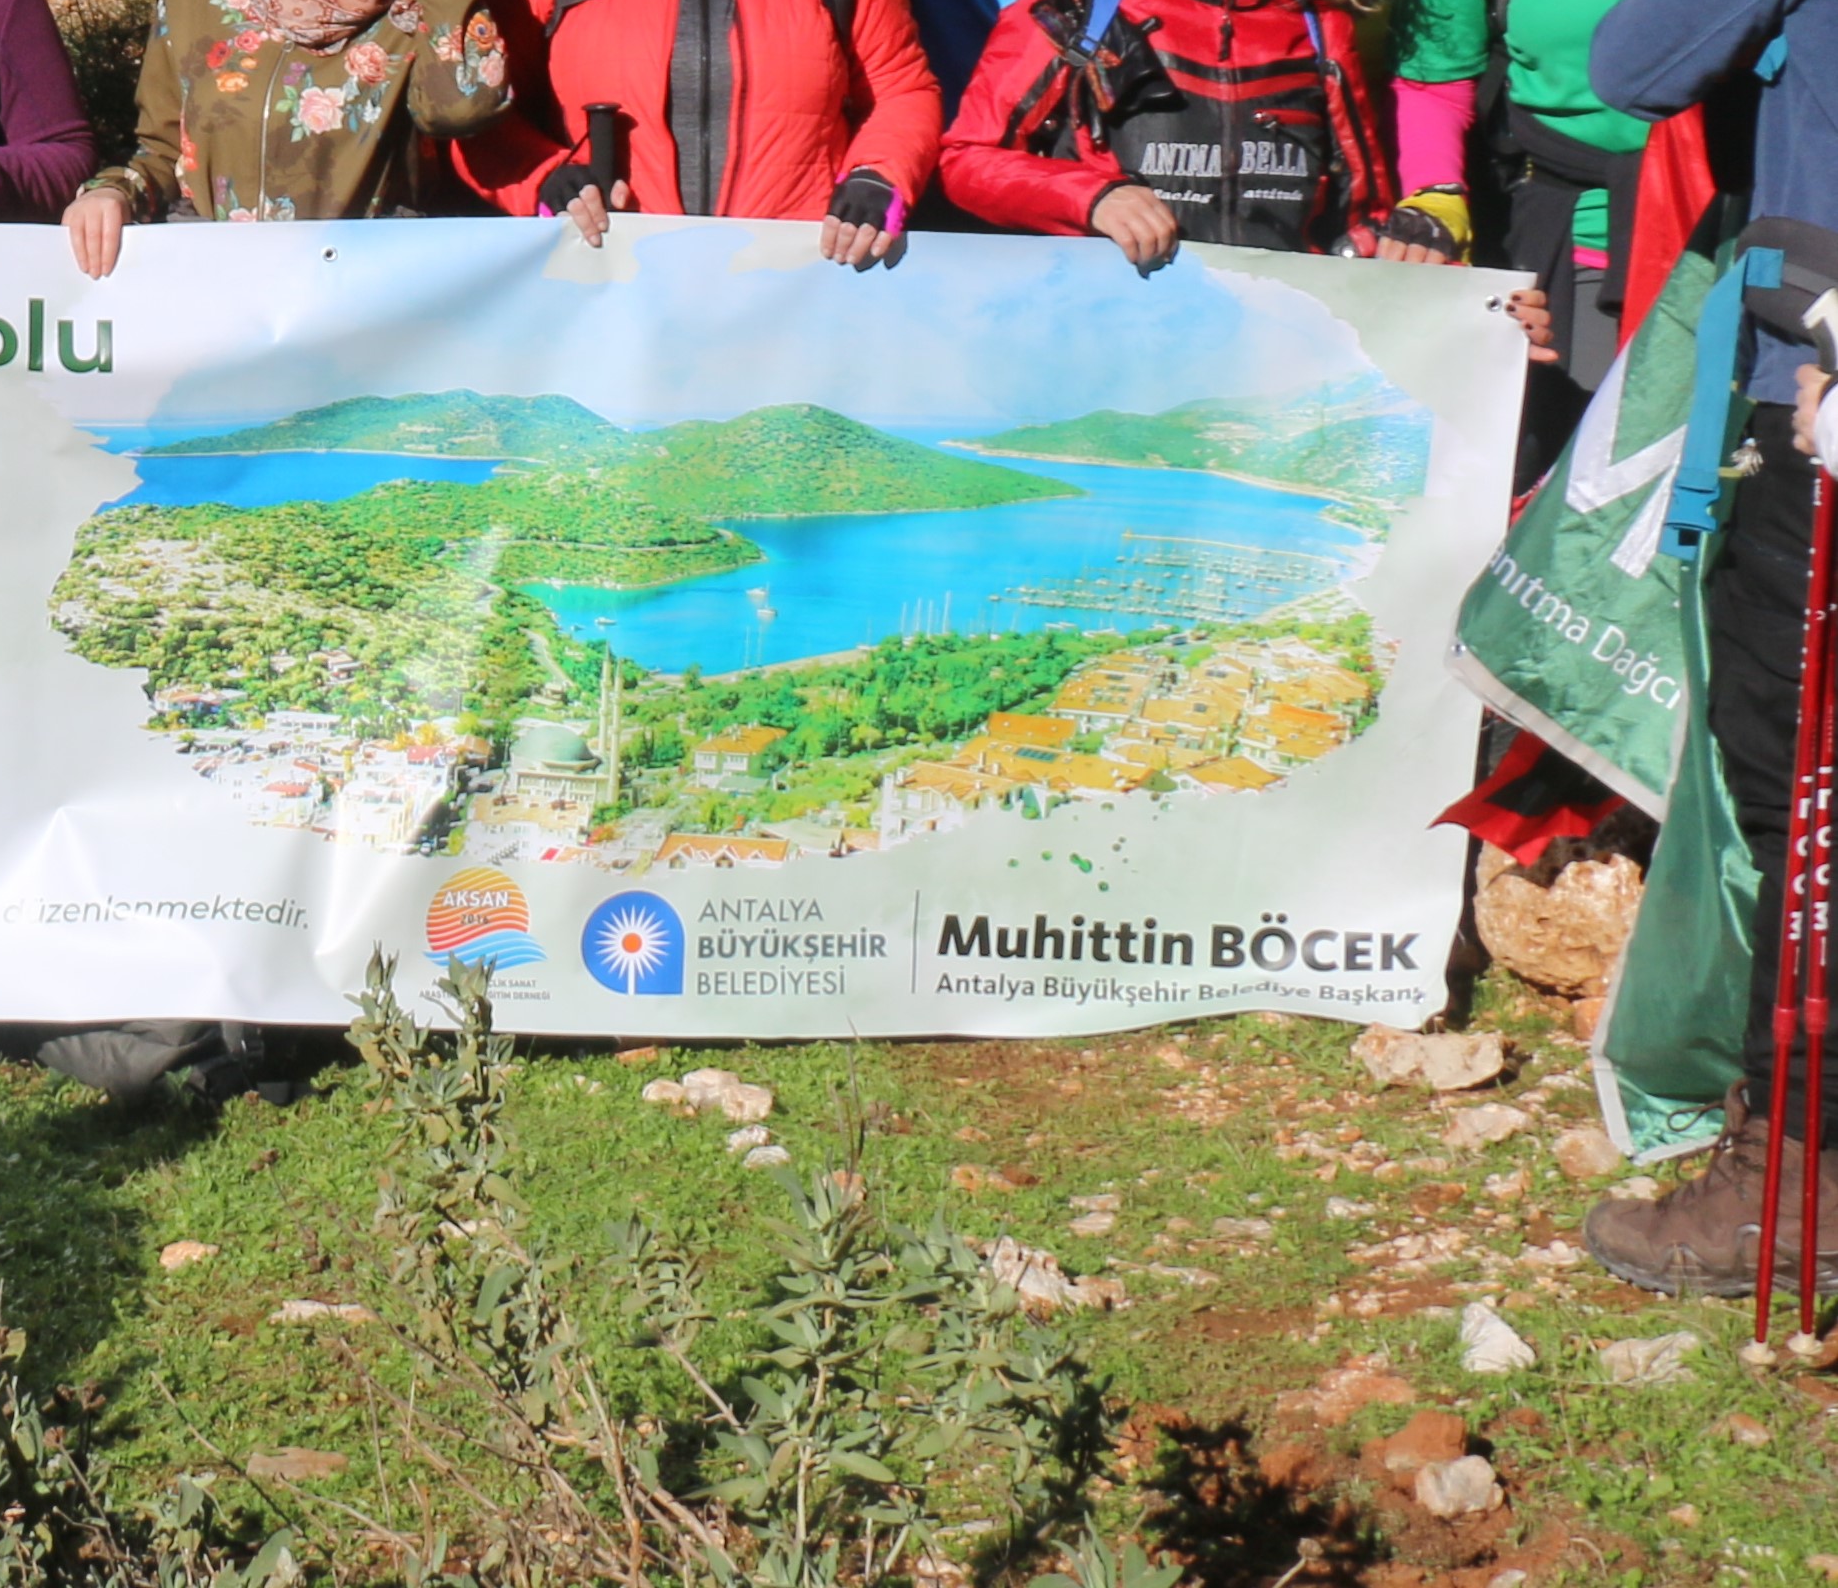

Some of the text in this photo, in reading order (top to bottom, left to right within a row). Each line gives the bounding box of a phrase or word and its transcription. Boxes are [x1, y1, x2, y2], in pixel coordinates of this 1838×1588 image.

[1139, 141, 1308, 177] ANIMA BELLA
[442, 890, 509, 907] AKSAN
[698, 898, 824, 922] ANTALYA
[698, 927, 887, 964] BÜYÜKŞEHİR
[937, 912, 1421, 972] Muhittin BÖCEK
[697, 964, 845, 996] BELEDİYESİ
[936, 972, 1035, 1002] Antalya
[1043, 975, 1191, 1007] Büyükşehir
[1198, 980, 1311, 1002] Belediye
